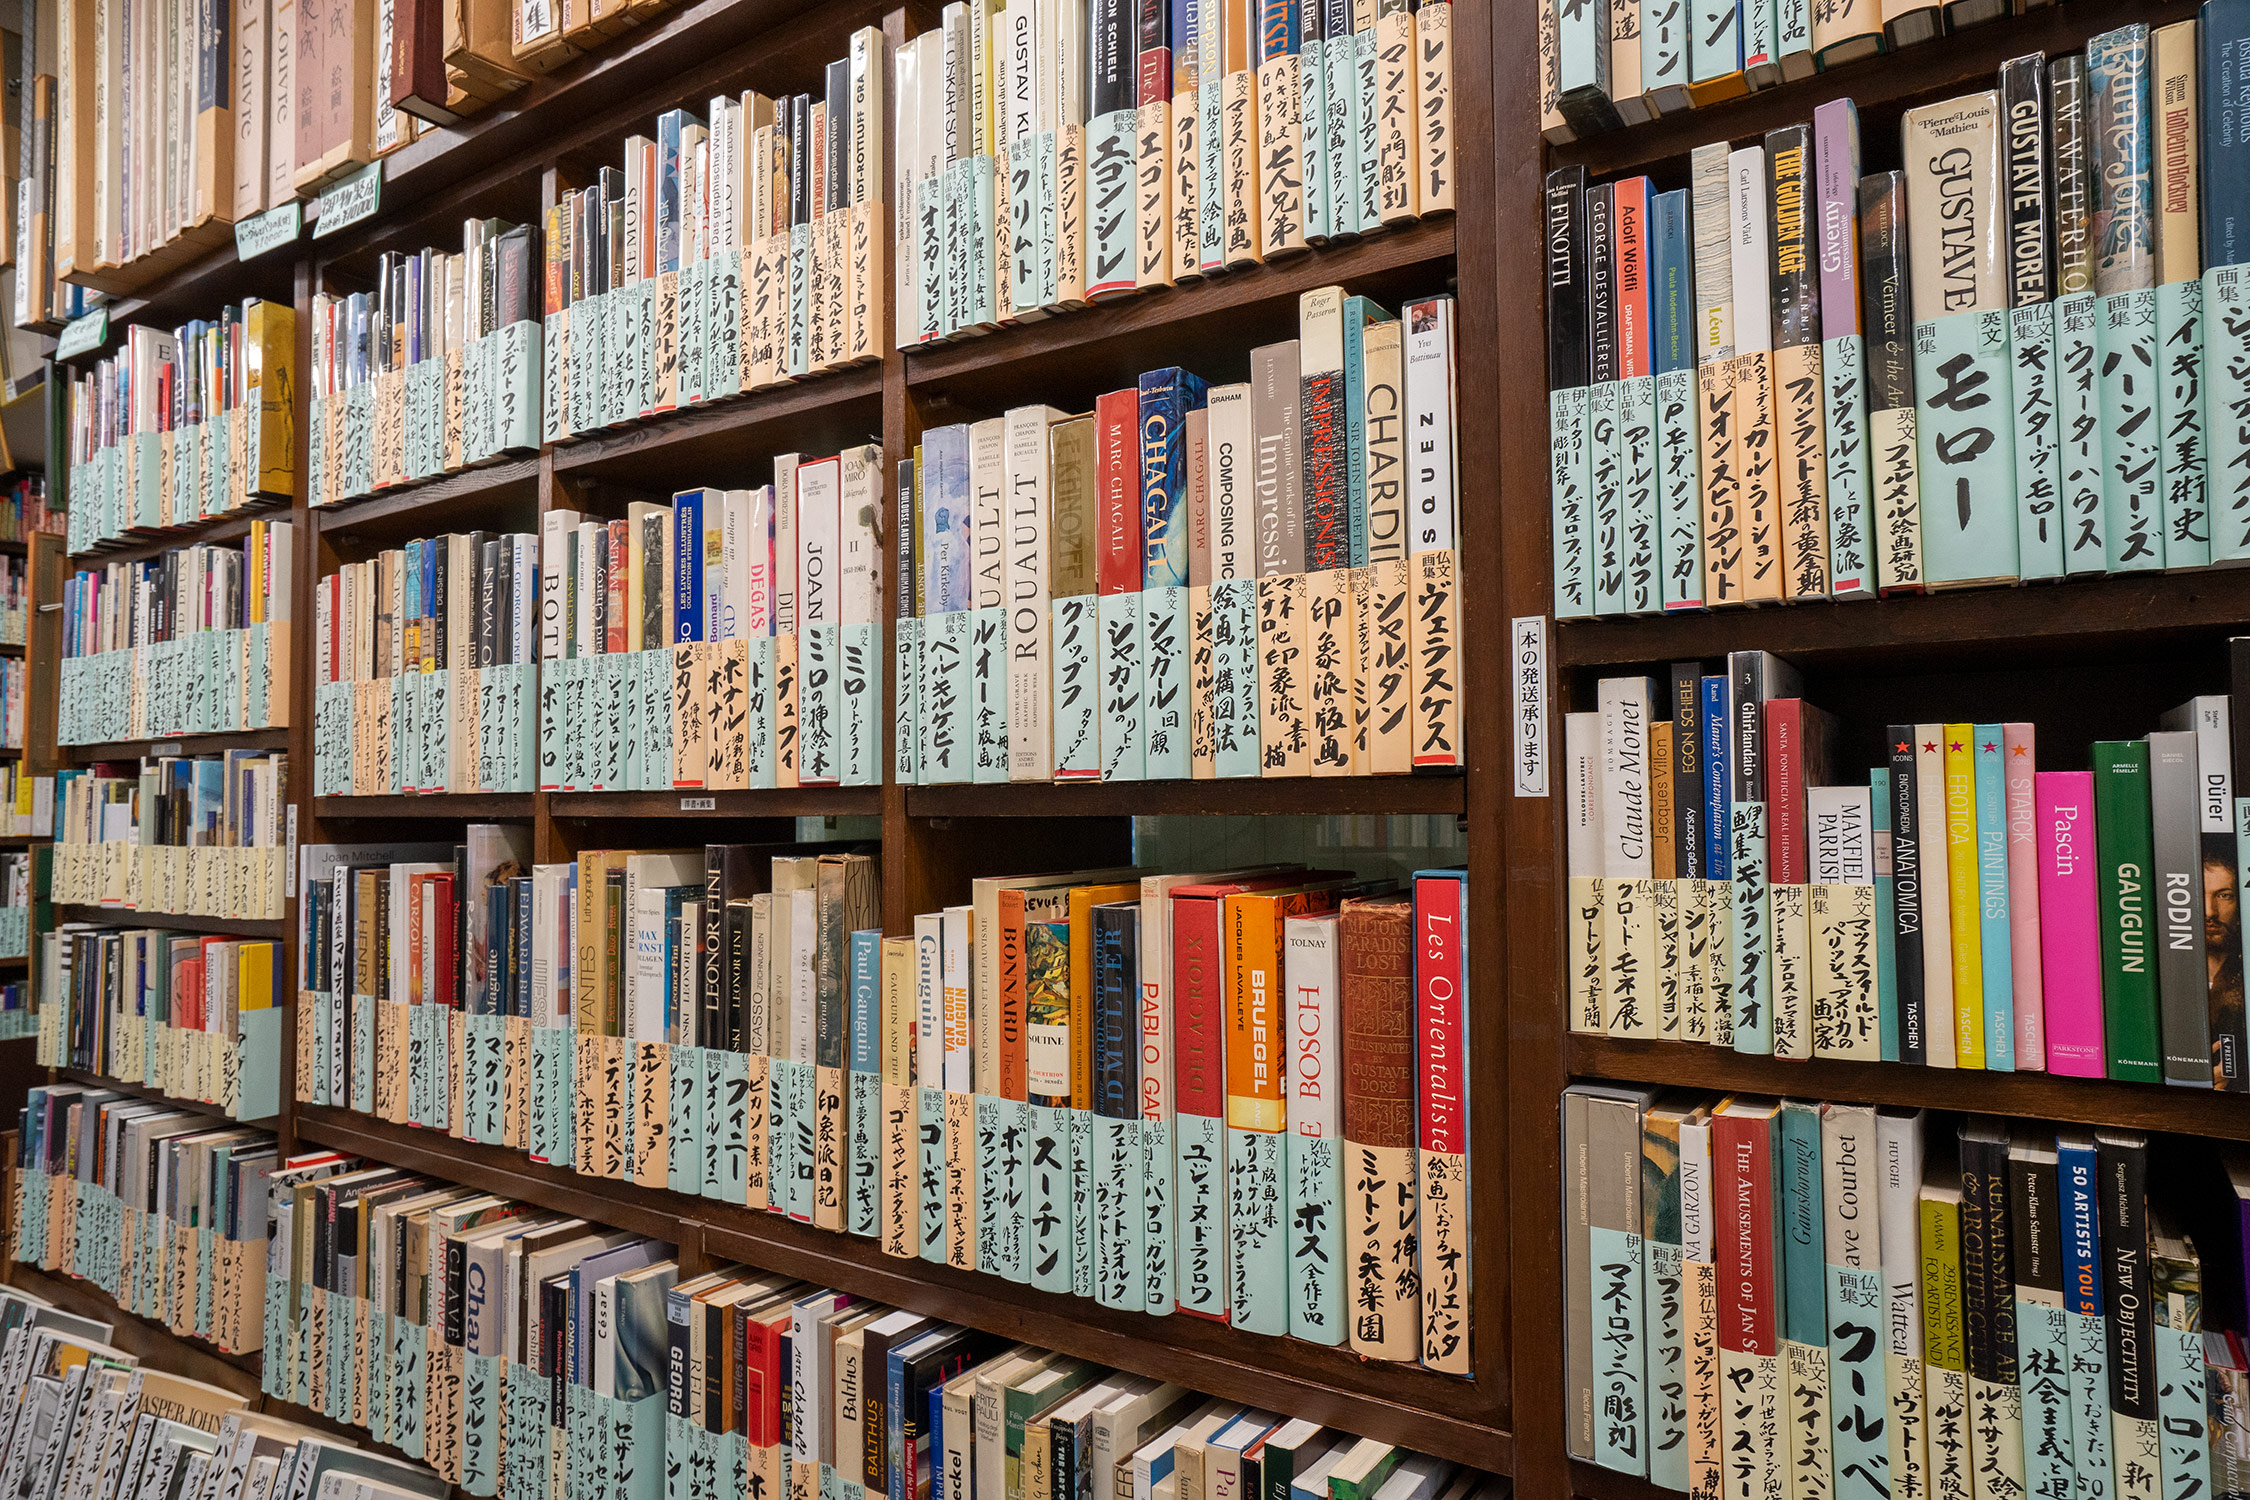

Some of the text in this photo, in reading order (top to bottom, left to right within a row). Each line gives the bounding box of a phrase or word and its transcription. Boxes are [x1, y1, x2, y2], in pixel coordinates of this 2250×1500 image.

[1015, 15, 1028, 101] GUSTAV
[1107, 22, 1117, 83] SCHIELE
[2165, 77, 2173, 106] Wilson
[2176, 74, 2188, 102] Simon
[1423, 38, 1448, 198] レンブラント
[1930, 122, 1978, 138] Mathieu
[2219, 41, 2234, 147] The Creation of Celebrity
[2101, 41, 2151, 256] Burne-Jones
[1012, 168, 1033, 285] クリムト
[1740, 168, 1752, 246] Carl Larssons Värld
[1823, 200, 1844, 273] Giverny
[1879, 202, 1888, 248] WHEELOCK
[1929, 147, 1977, 312] GUSTAVE
[2010, 100, 2044, 307] GUSTAVE MOREA
[1551, 201, 1571, 288] FINOTTI
[1622, 205, 1638, 292] Adolf Wölfli
[1842, 214, 1851, 280] impressionniste
[1306, 307, 1337, 320] Passeron
[1310, 295, 1331, 308] Roger
[1594, 201, 1611, 380] GEORGE DESVALLIÈRES
[1670, 295, 1678, 361] Modersohn-Becker
[1709, 306, 1721, 347] Léon
[1883, 274, 1898, 335] Vermeer
[1417, 339, 1432, 348] Yves
[1210, 393, 1242, 404] GRAHAM
[2165, 317, 2209, 542] イギリス美術史
[1284, 427, 1295, 505] Graphic Works
[1312, 377, 1336, 569] IMPRESSIONIS
[1926, 353, 1995, 531] モロー
[2064, 340, 2102, 551] ウォーターハウス
[1109, 425, 1124, 556] MARC CHAGALL
[1145, 414, 1168, 579] CHAGALL
[1195, 438, 1205, 550] MARC CHAGALL
[1219, 442, 1234, 547] COMPOSING
[1352, 487, 1362, 549] EVERETT
[482, 567, 493, 637] MARINI
[751, 564, 765, 630] DEGAS
[807, 542, 823, 620] JOAN
[1013, 473, 1037, 663] ROUAULT
[710, 593, 718, 643] Bonnard
[844, 644, 867, 696] ミロ
[973, 619, 997, 703] ルオー
[1148, 612, 1182, 709] シャガール
[1310, 596, 1349, 767] 印象派の版画
[1374, 591, 1409, 735] シャルダン
[1418, 580, 1453, 752] ヴェラスケス
[542, 677, 561, 767] ボテロ
[1520, 631, 1540, 777] 本の発送承ります
[1680, 679, 1695, 774] EGON SCHIELE
[1742, 703, 1756, 776] Ghirlandaio
[1620, 699, 1643, 860] Claude Monet
[1654, 738, 1669, 844] Jacques Villon
[1709, 762, 1725, 839] Contemplation
[1949, 774, 1969, 846] EROTICA
[2011, 777, 2033, 844] STARCK
[2207, 774, 2225, 822] Dürer
[321, 852, 394, 863] Joan Mitchell
[1686, 808, 1697, 878] Serge Sabarsky
[1841, 804, 1863, 884] MAXFIEL
[1896, 773, 1918, 935] ENCYCLOPAEDIA ANATOMICA
[1983, 831, 2006, 920] PAINTINGS
[2054, 804, 2079, 877] Pascin
[410, 883, 420, 954] CARZOU
[584, 855, 593, 923] Lithographies
[2118, 863, 2144, 973] GAUGUIN
[2166, 873, 2193, 951] RODIN
[358, 920, 367, 993] HENRY
[705, 869, 721, 1010] LEONOR FINI
[1290, 938, 1326, 948] TOLNAY
[1356, 954, 1401, 970] LOST
[1427, 912, 1452, 960] Les
[1736, 859, 1766, 1029] ギルランダイオ
[853, 941, 872, 1063] Paul Gauguin
[890, 972, 898, 1025] GAUGUIN
[920, 934, 937, 1038] Gauguin
[945, 986, 955, 1052] VAN GOGH
[956, 987, 967, 1047] GAUGUIN
[1003, 927, 1018, 1077] BONNARD The
[1143, 983, 1159, 1064] PABLO
[1188, 936, 1206, 1094] DELACROIX
[1236, 965, 1244, 1032] LAVALLEYE
[1029, 1034, 1064, 1046] SOUTINE
[1251, 969, 1267, 1094] BRUEGEL
[1298, 984, 1321, 1101] BOSCH
[1350, 1040, 1411, 1054] ILLUSTRATED
[1906, 1002, 1918, 1049] TASCHEN
[1960, 1006, 1972, 1054] TASCHEN
[1994, 1010, 2006, 1058] TASCHEN
[2118, 1059, 2158, 1067] KÖNEMANN
[2166, 1055, 2209, 1064] KÖNEMANN
[1352, 1062, 1410, 1079] GUSTAVE
[1360, 1079, 1397, 1094] DORÉ
[818, 1089, 840, 1208] 印象派日記
[920, 1116, 944, 1246] ゴーギャン
[1000, 1125, 1027, 1210] ボナール
[1579, 1143, 1587, 1175] Umberto
[1624, 1152, 1632, 1184] Umberto
[1836, 1134, 1856, 1220] Courbet
[1888, 1140, 1899, 1189] HUYGHE
[1032, 1136, 1062, 1276] スーチン
[1684, 1161, 1699, 1234] GARZONI
[1790, 1137, 1817, 1245] Gainsborough
[2028, 1172, 2040, 1257] Peter-Klaus Schuster
[1293, 1200, 1333, 1264] ボス
[1737, 1141, 1757, 1329] THE AMUSEMENTS OF JAN
[1934, 1210, 1944, 1251] AMMAN
[2073, 1166, 2093, 1296] 50 ARTISTS YOU
[598, 1291, 608, 1339] César
[1697, 1266, 1716, 1331] 英独仏文
[2117, 1248, 2140, 1406] NEW OBJECTIVITY
[670, 1345, 684, 1414] GEORG
[867, 1399, 878, 1477] BALTHUS
